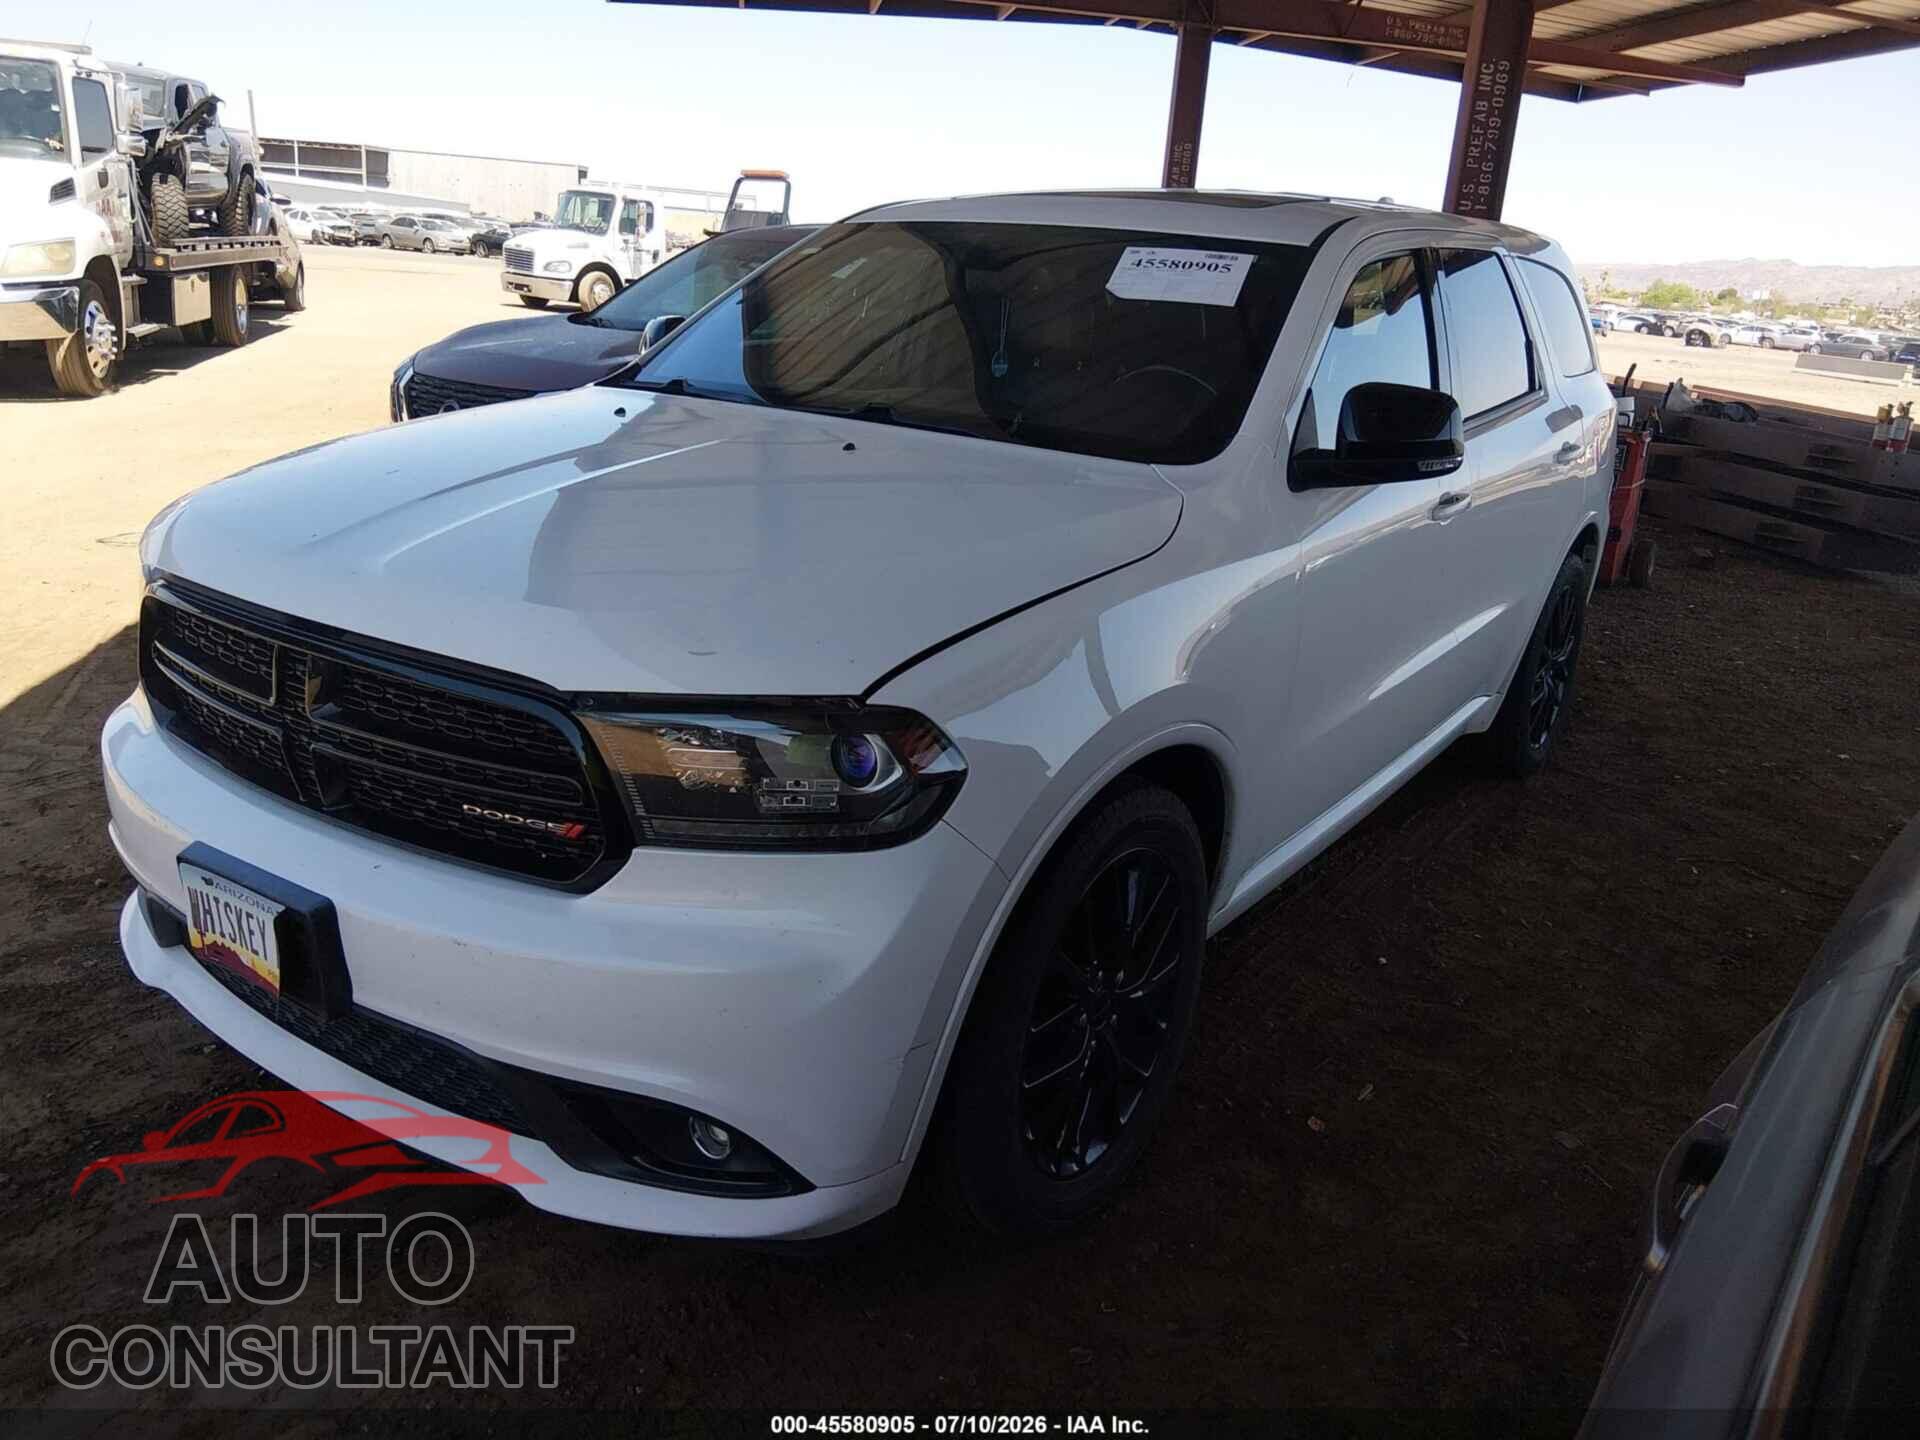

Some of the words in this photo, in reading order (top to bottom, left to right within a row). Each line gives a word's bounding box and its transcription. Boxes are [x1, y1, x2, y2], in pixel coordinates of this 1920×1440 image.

[1479, 58, 1496, 91] INC.
[1466, 101, 1489, 168] PREFAB
[1474, 61, 1510, 210] 1-866-799-0969
[1459, 179, 1476, 211] U.S.
[1131, 258, 1232, 274] 45580905
[462, 804, 567, 834] DODGE
[215, 882, 274, 916] ARIZONA
[187, 886, 268, 961] WHISKEY
